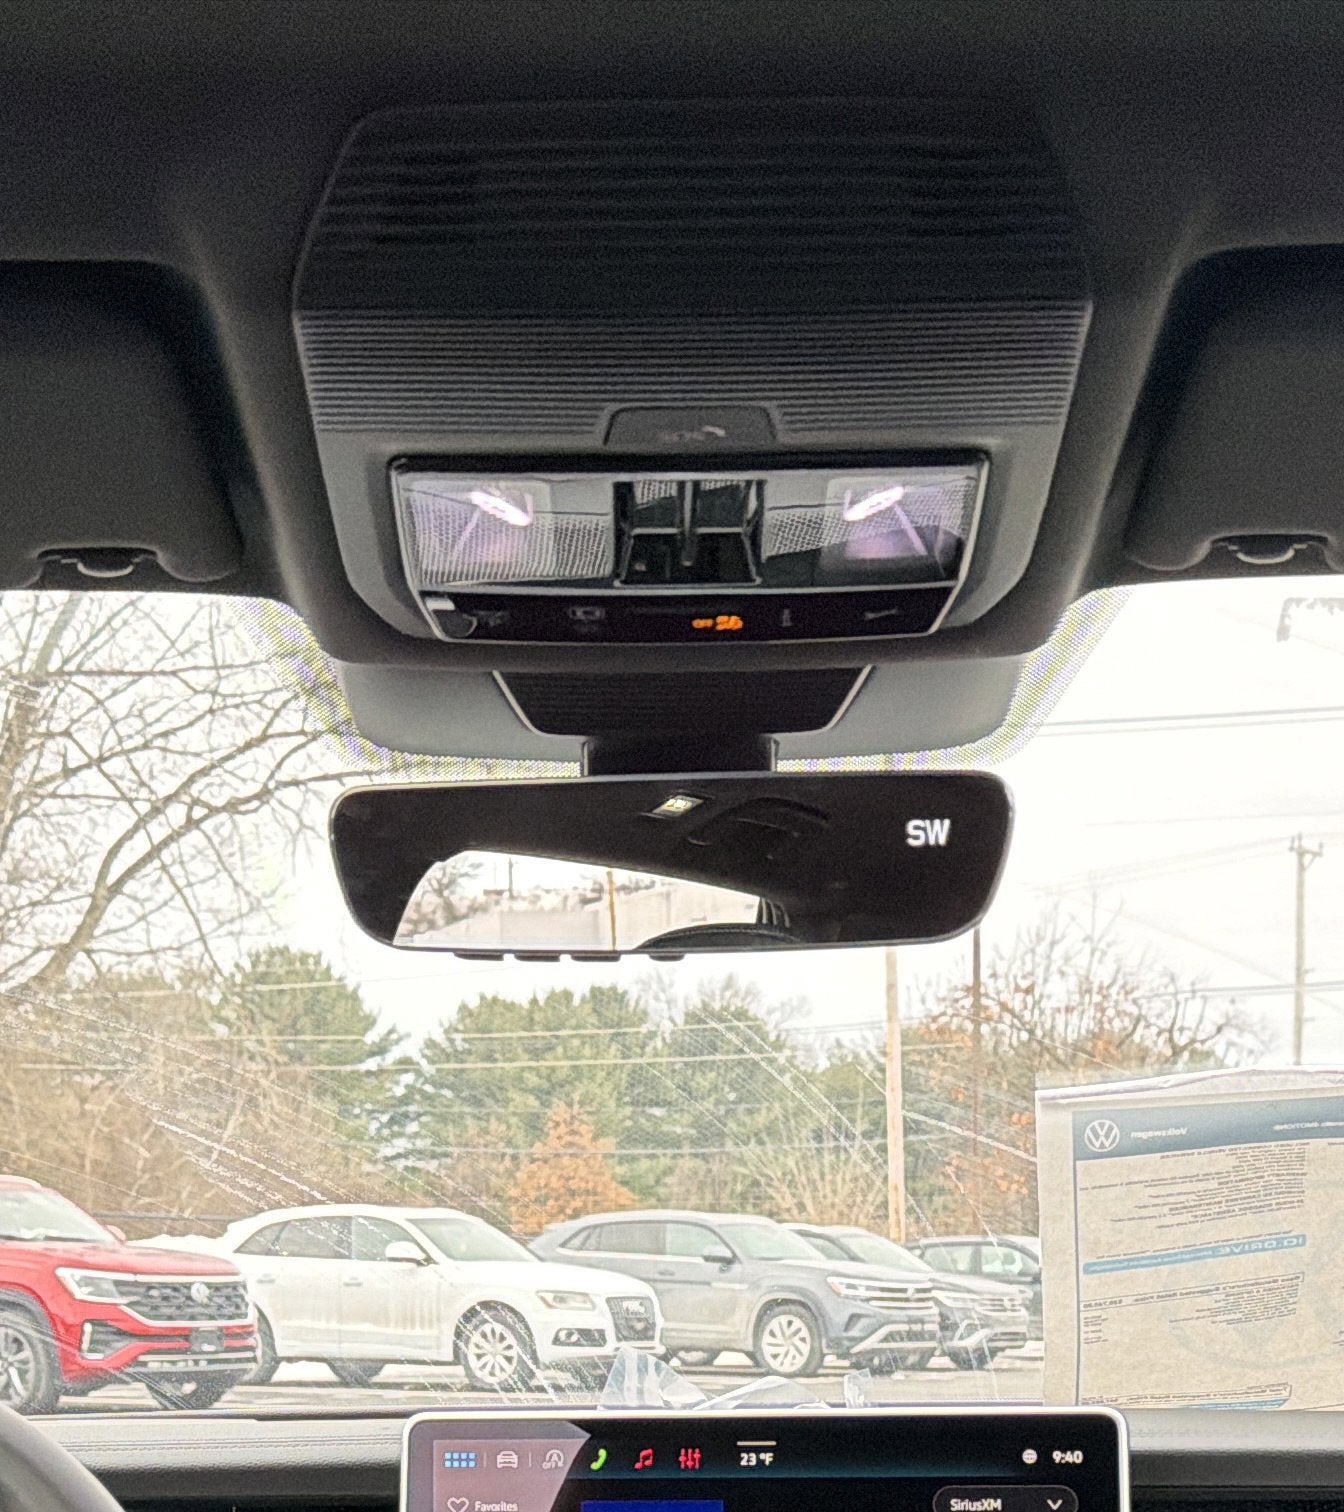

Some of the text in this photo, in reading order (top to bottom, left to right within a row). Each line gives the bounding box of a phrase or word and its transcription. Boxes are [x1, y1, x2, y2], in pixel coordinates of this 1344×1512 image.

[906, 818, 951, 847] SW
[740, 1453, 757, 1466] 23
[1052, 1450, 1084, 1464] 9:40
[475, 1501, 518, 1512] Favorites
[950, 1498, 1002, 1511] SiriusXM
